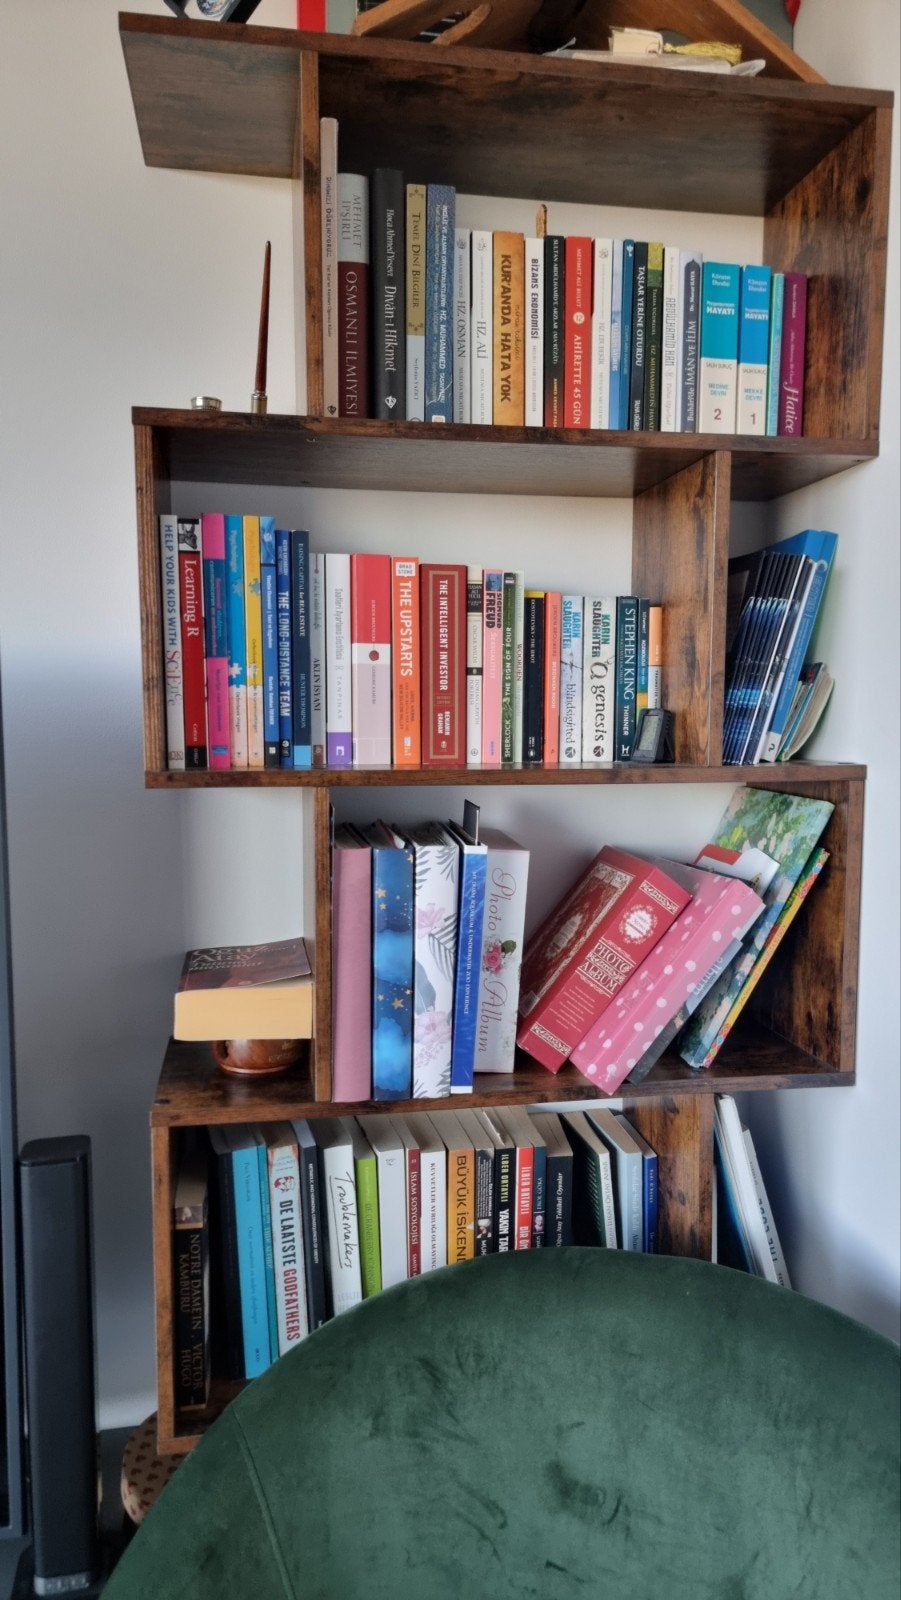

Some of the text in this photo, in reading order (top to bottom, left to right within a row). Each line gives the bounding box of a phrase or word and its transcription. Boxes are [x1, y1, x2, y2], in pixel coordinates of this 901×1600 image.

[351, 194, 362, 249] MEHMET
[386, 208, 395, 256] Hoca Ahmed
[440, 234, 448, 255] ALMAN
[411, 212, 422, 308] TEMEL BİLGİLER
[530, 258, 540, 289] BİZANS
[456, 300, 467, 358] HZ. OSMAN
[476, 320, 487, 339] HZ.
[530, 292, 540, 339] EKONOMİSİ
[635, 265, 646, 367] TAŞLAR YERİNE OTURDU
[706, 306, 735, 316] HAYATI
[744, 312, 769, 321] HAYATI
[346, 271, 359, 415] OSMANLI İLMİYESİ
[384, 329, 397, 372] Hikmet
[476, 341, 489, 359] ALİ
[665, 350, 676, 367] HAN
[685, 321, 697, 356] VE İLİM
[501, 332, 512, 403] HATA YOK
[573, 334, 584, 425] AHİRETTE 45 GÜN
[713, 408, 722, 421] 2
[751, 413, 757, 425] 1
[783, 381, 799, 433] Hatice
[164, 524, 178, 646] HELP YOUR KIDS WITH
[183, 559, 199, 638] Learning R
[399, 580, 414, 678] THE UPSTARTS
[485, 592, 497, 629] FREUD
[562, 600, 573, 649] SLAUGHTER
[573, 612, 582, 638] KARIN
[592, 600, 602, 658] SLAUGHTER
[602, 614, 611, 645] KARIN
[278, 590, 291, 717] THE LONG-DISTANCE TEAM
[439, 579, 449, 691] THE INTELLIGENT INVESTOR
[472, 643, 480, 664] WILDE
[505, 649, 512, 661] OF
[623, 607, 636, 700] STEPHEN KING
[313, 657, 323, 712] AKLIN İSYANI
[563, 683, 577, 744] blindsighted
[591, 685, 608, 742] genesis
[622, 705, 630, 736] THINNER
[504, 719, 512, 758] SHERLOCK
[469, 899, 477, 928] AQUARIUM
[466, 935, 474, 970] UNDERWATER
[478, 867, 517, 1052] Photo Album
[594, 942, 631, 974] PHOTO
[463, 984, 472, 1015] EXPERIENCE
[580, 961, 618, 992] ALBUM
[456, 1155, 470, 1208] BÜYÜK
[500, 1153, 510, 1202] İLBER ORTAYLI
[520, 1166, 532, 1215] İLBER ORTAYLI
[556, 1172, 564, 1196] Oyunlar
[604, 1182, 612, 1205] OKTAY
[335, 1170, 358, 1269] Troublemakers
[410, 1171, 420, 1244] İSLAM SOSYOLOJİSİ
[498, 1208, 510, 1234] YAKIN
[190, 1233, 202, 1274] NOTRE
[279, 1199, 301, 1340] DE LAATSTE GODFATHERS
[179, 1253, 190, 1312] KAMBURU
[181, 1348, 192, 1386] HUGO
[192, 1342, 203, 1390] VICTOR
